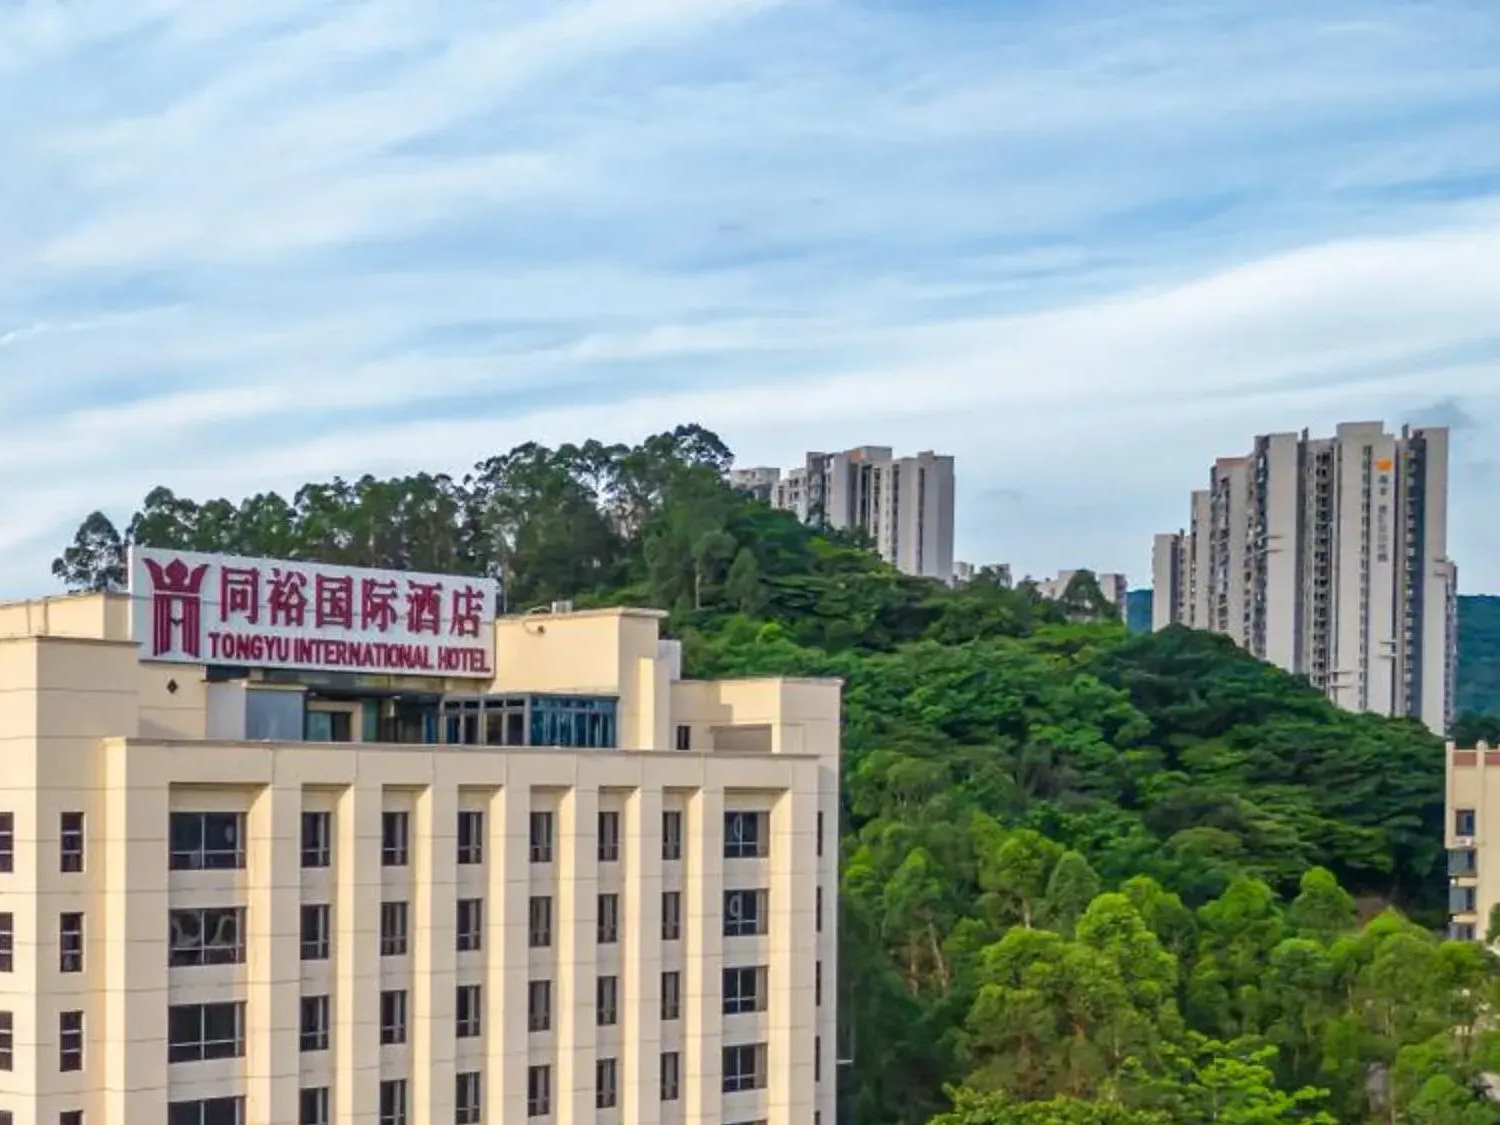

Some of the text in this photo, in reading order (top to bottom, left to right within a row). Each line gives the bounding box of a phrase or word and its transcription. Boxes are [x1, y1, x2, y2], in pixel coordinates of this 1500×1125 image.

[218, 564, 485, 639] 同裕国际酒店
[208, 631, 492, 674] TONGYU INTERNATIONAL HOTEL
